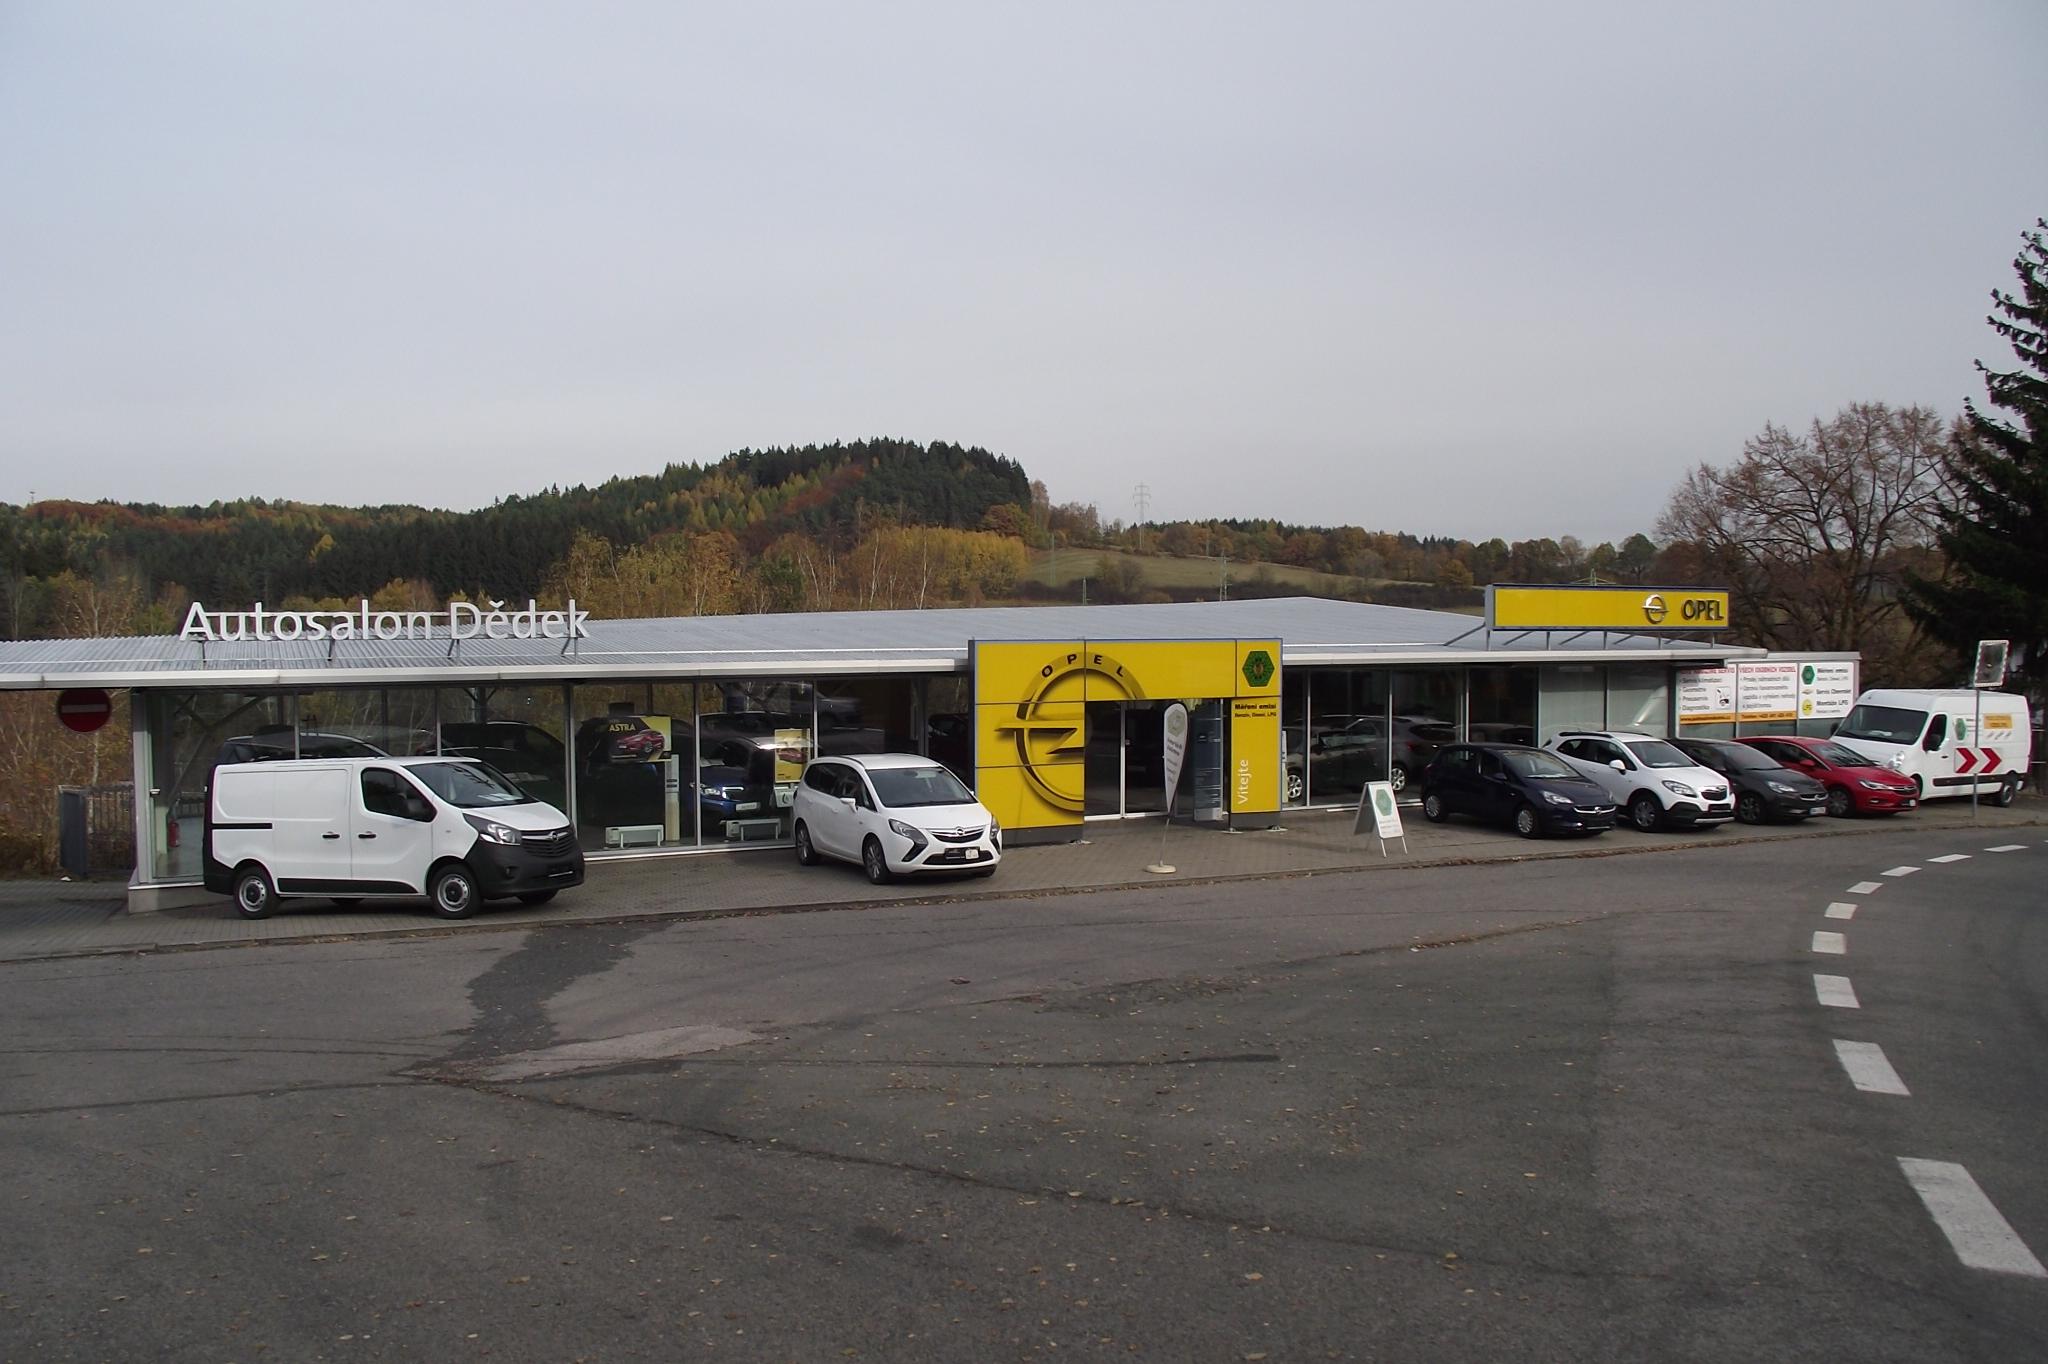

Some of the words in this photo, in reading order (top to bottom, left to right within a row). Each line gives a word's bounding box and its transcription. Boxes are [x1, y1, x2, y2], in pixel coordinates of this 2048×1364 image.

[180, 599, 432, 641] Autosalon
[449, 598, 590, 640] Dědek
[1681, 600, 1724, 620] OPEL
[1041, 653, 1125, 678] OPEL
[609, 723, 635, 732] ASTRA
[1238, 759, 1252, 805] Vítejte
